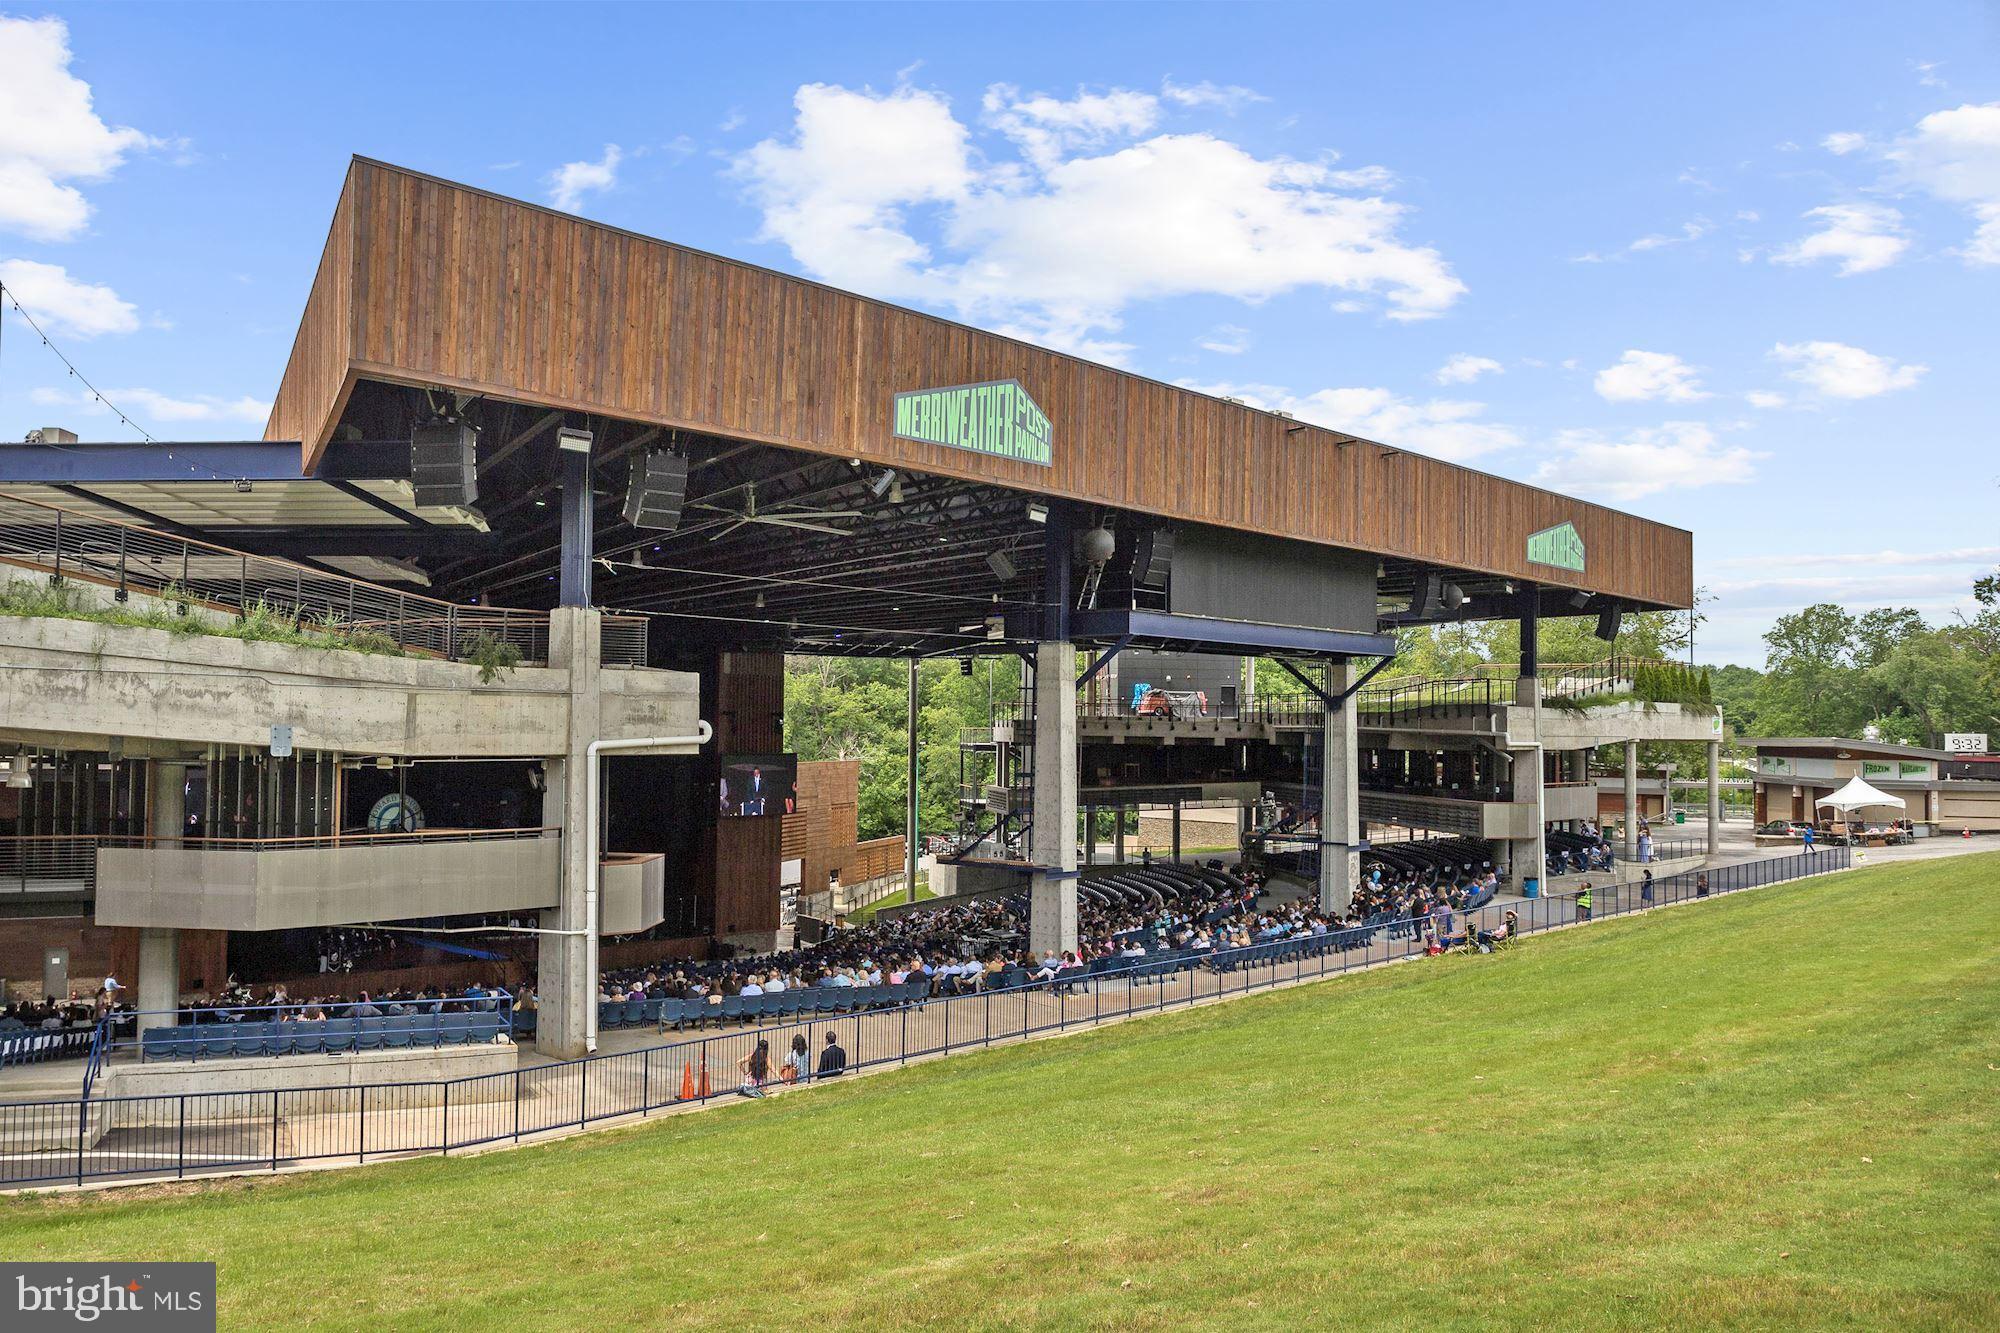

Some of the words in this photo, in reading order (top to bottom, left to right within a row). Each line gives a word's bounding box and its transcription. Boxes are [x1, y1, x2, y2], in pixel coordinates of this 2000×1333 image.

[897, 383, 1014, 456] MERRIWEATHER
[1016, 385, 1051, 444] POST
[1015, 424, 1050, 463] PAVILION
[1952, 738, 1982, 750] 9:32
